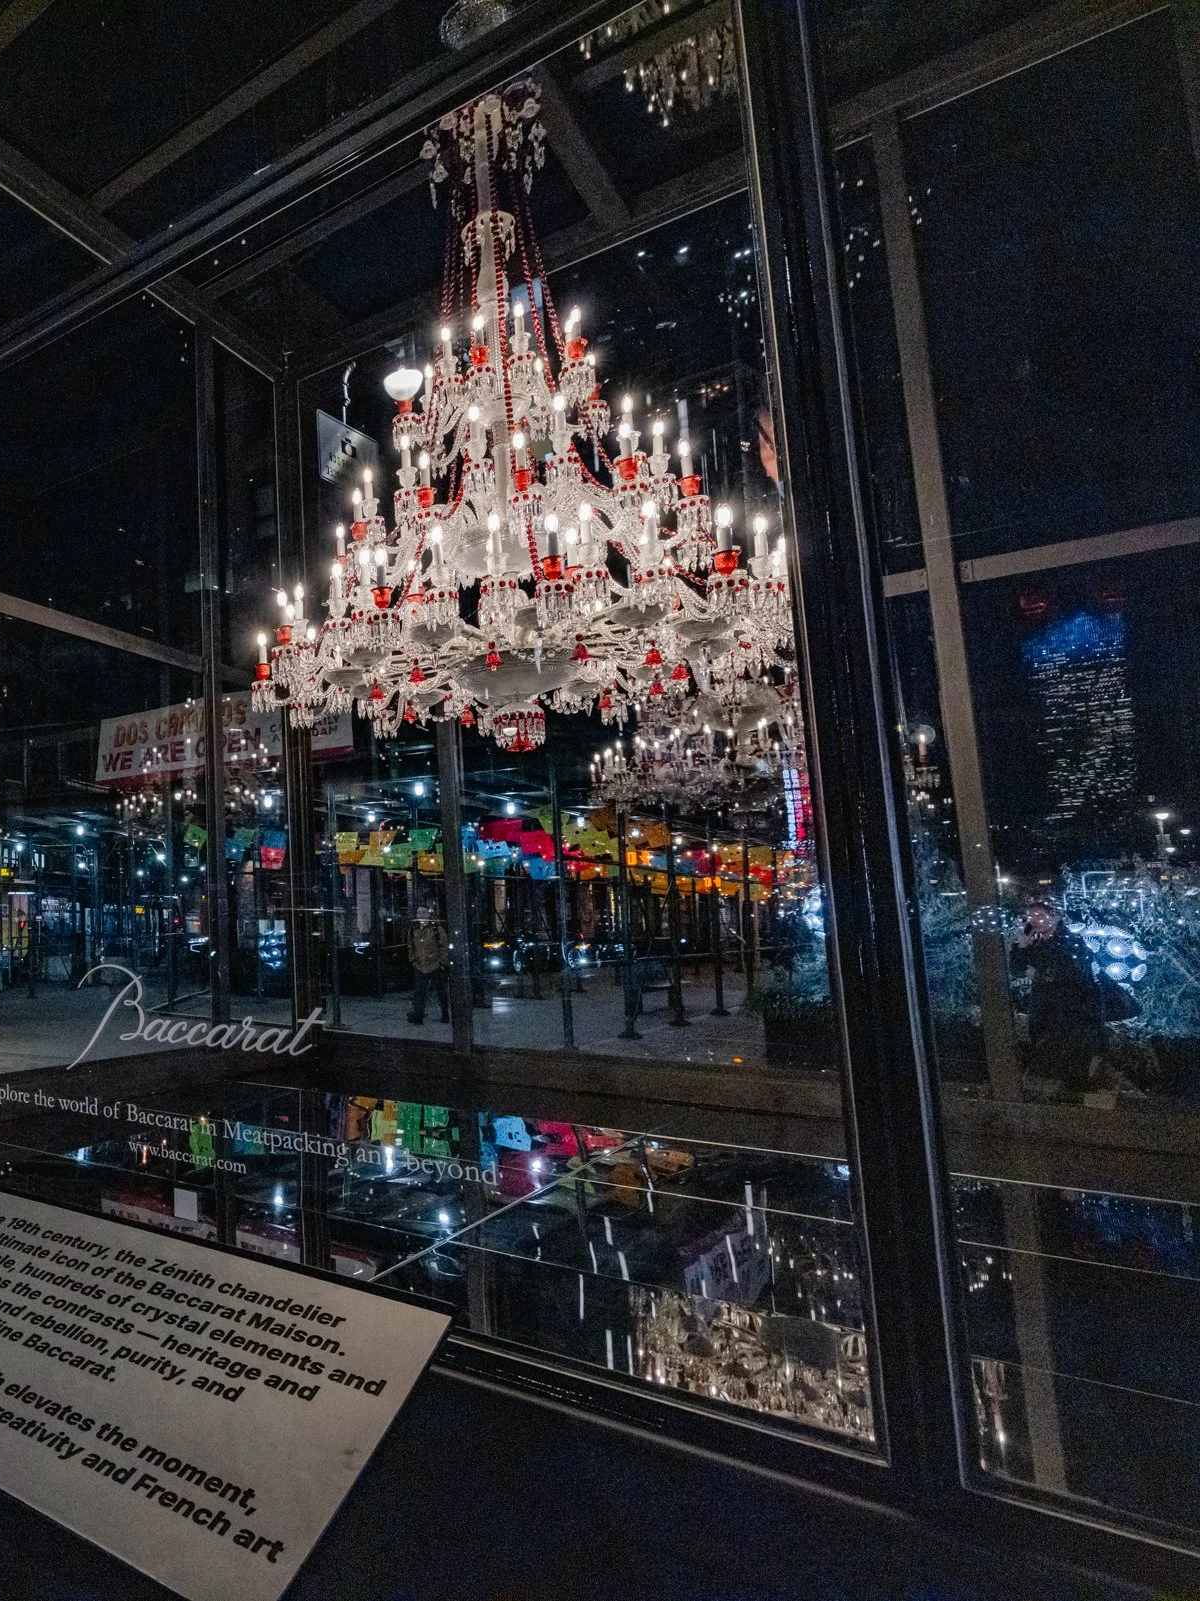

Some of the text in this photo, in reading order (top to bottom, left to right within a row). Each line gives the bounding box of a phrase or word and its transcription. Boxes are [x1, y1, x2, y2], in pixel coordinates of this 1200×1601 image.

[102, 750, 134, 773] WE
[139, 740, 186, 768] ARE
[113, 720, 148, 748] DOS
[66, 963, 326, 1070] Baccarat
[34, 1089, 55, 1108] the
[59, 1097, 99, 1117] world
[103, 1101, 120, 1120] of
[126, 1103, 195, 1132] Baccarat
[200, 1118, 217, 1136] in
[223, 1119, 350, 1167] Meatpacking
[356, 1145, 393, 1167] an
[403, 1148, 499, 1186] beyond
[128, 1139, 247, 1174] www.baccarat.com
[7, 1217, 42, 1236] 19th
[42, 1229, 110, 1260] century,
[115, 1249, 147, 1268] the
[147, 1258, 215, 1289] Zénith
[218, 1283, 347, 1328] chandelier
[50, 1252, 90, 1273] icon
[91, 1265, 115, 1280] of
[113, 1271, 147, 1290] the
[147, 1281, 247, 1324] Baccarat
[247, 1312, 346, 1357] Maison.
[11, 1281, 42, 1301] the
[42, 1295, 135, 1335] contrasts
[160, 1335, 262, 1380] heritage
[264, 1373, 321, 1402] and
[19, 1262, 106, 1300] hundreds
[106, 1293, 134, 1308] of
[131, 1302, 210, 1335] crystal
[209, 1328, 325, 1376] elements
[328, 1368, 387, 1397] and
[21, 1333, 116, 1382] Baccarat.
[22, 1311, 109, 1355] rebellion,
[111, 1345, 188, 1386] purity,
[191, 1375, 246, 1402] and
[4, 1383, 96, 1432] elevates
[96, 1422, 138, 1452] the
[138, 1445, 257, 1516] moment,
[81, 1453, 137, 1485] and
[131, 1473, 233, 1537] French
[232, 1528, 285, 1564] art
